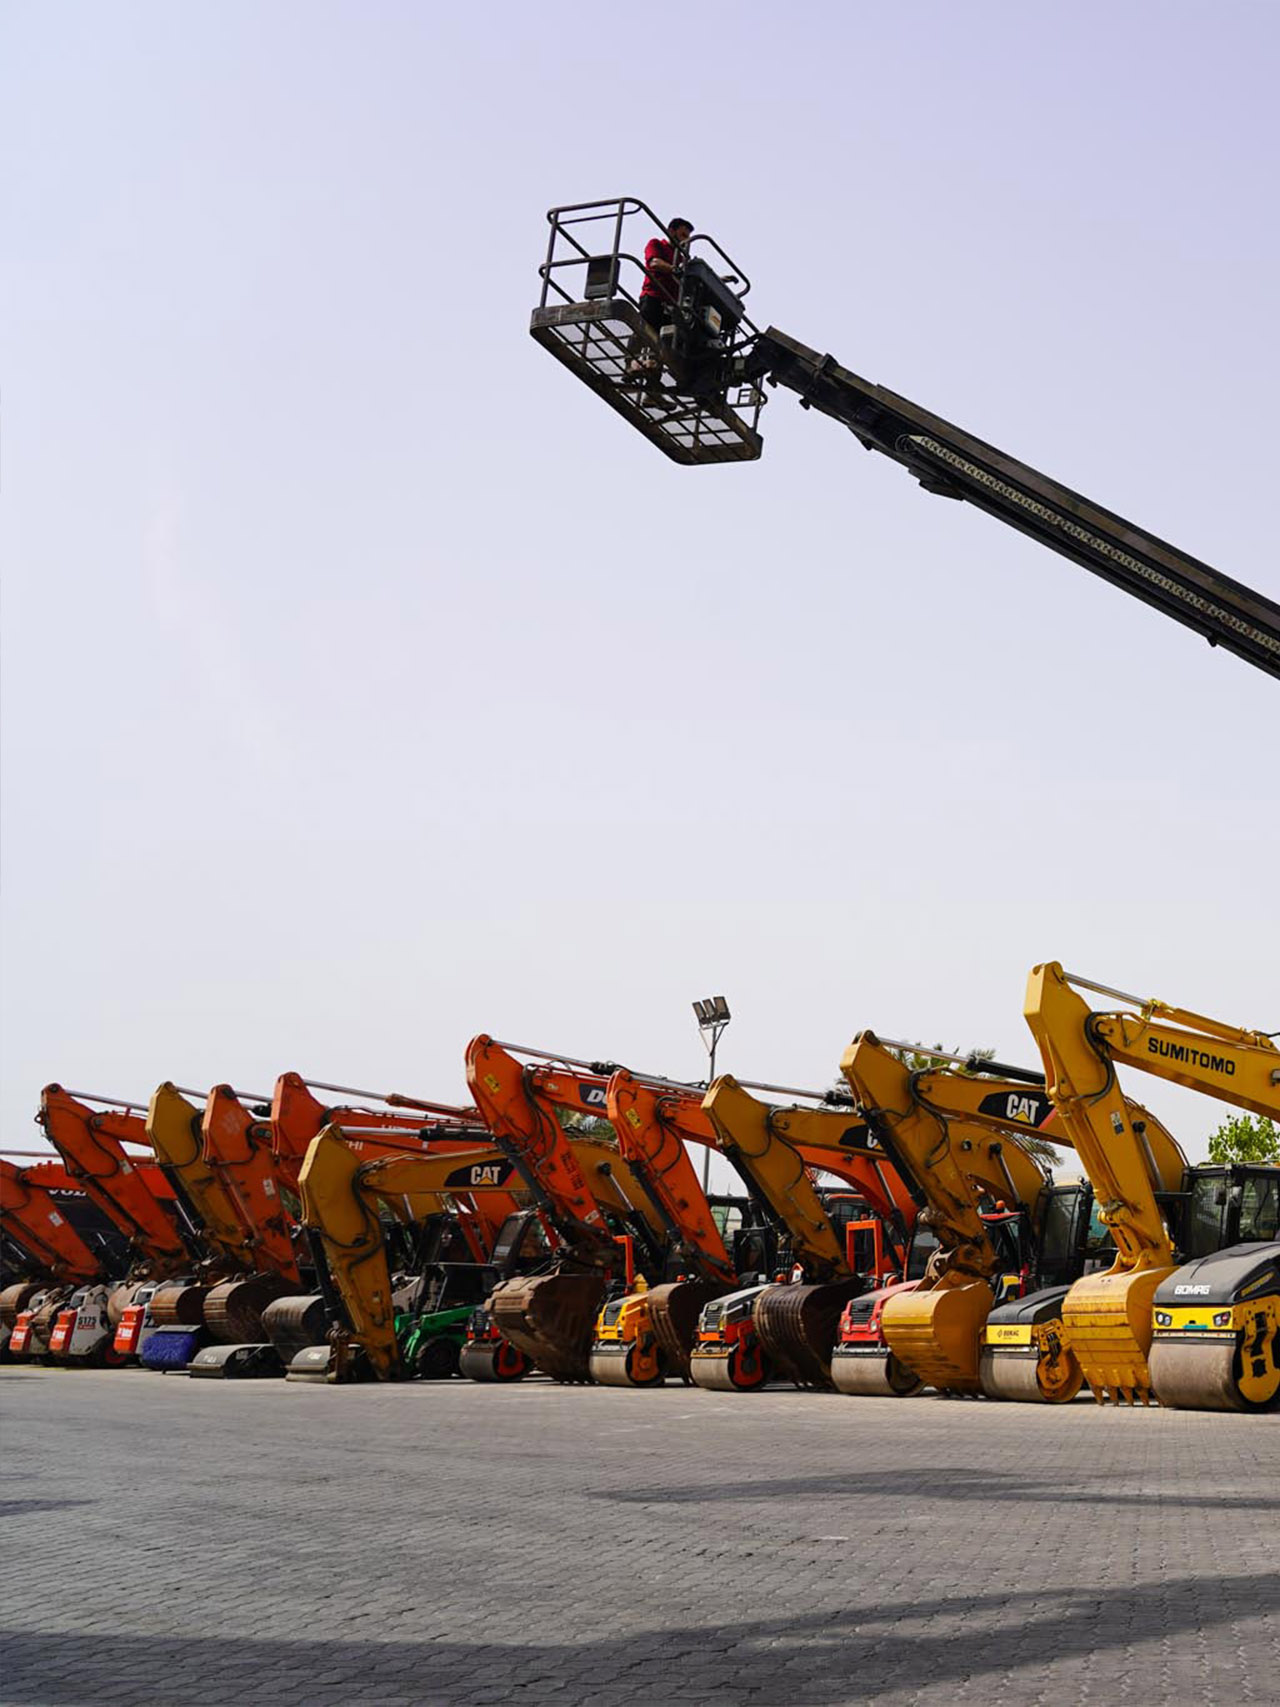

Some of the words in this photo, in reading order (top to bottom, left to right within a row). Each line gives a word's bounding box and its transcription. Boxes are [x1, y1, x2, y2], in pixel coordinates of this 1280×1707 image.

[1148, 1037, 1236, 1075] SUMITOMO
[1006, 1094, 1040, 1125] CAT
[470, 1166, 501, 1185] CAT
[1174, 1284, 1211, 1295] BOMAG
